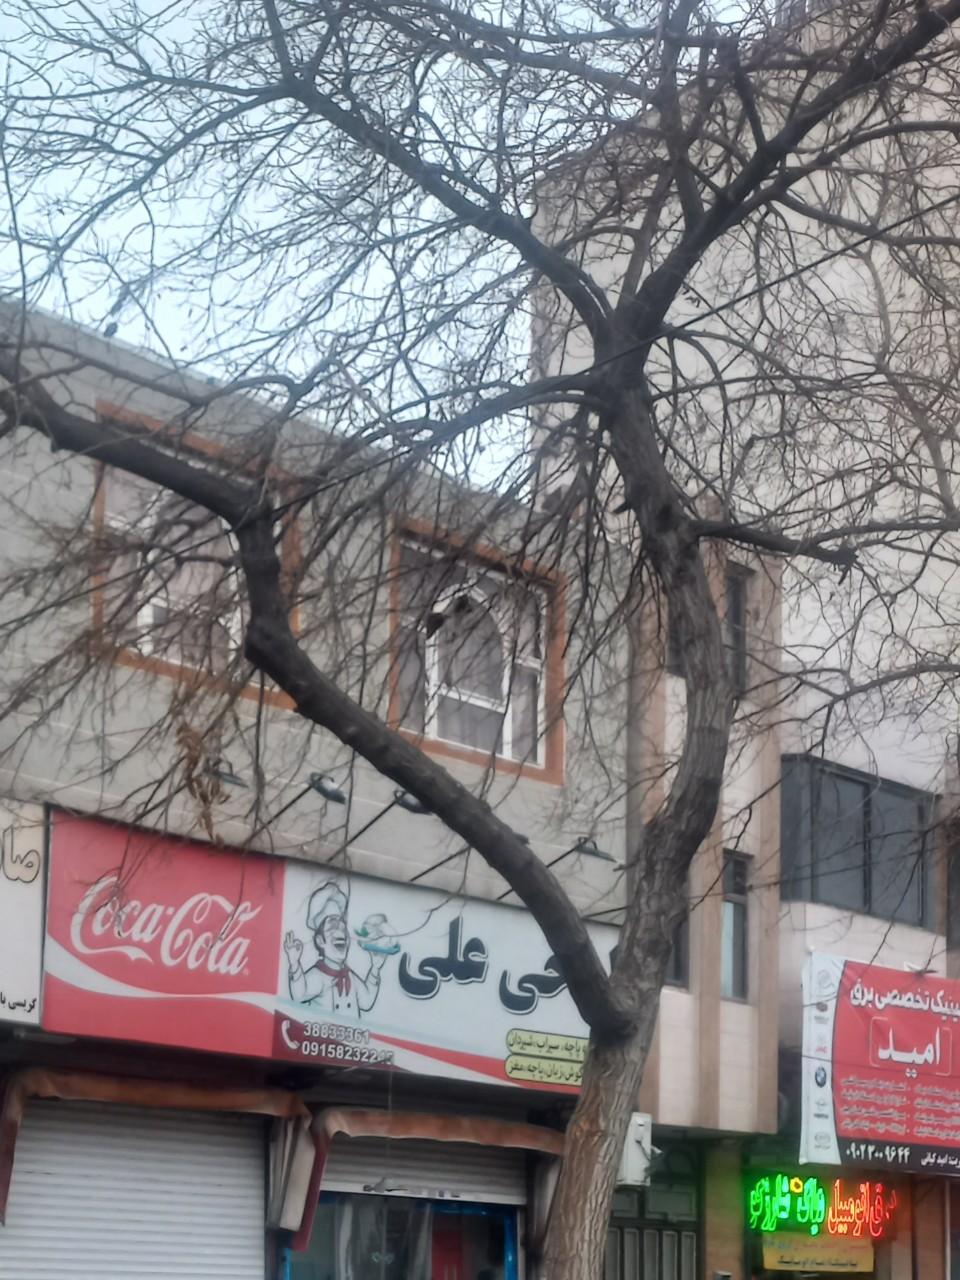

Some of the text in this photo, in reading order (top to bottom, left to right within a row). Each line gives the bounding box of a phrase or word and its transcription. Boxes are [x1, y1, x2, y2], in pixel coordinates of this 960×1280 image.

[70, 875, 262, 976] Coca-Cola
[398, 915, 488, 999] علی
[878, 1026, 940, 1078] امید
